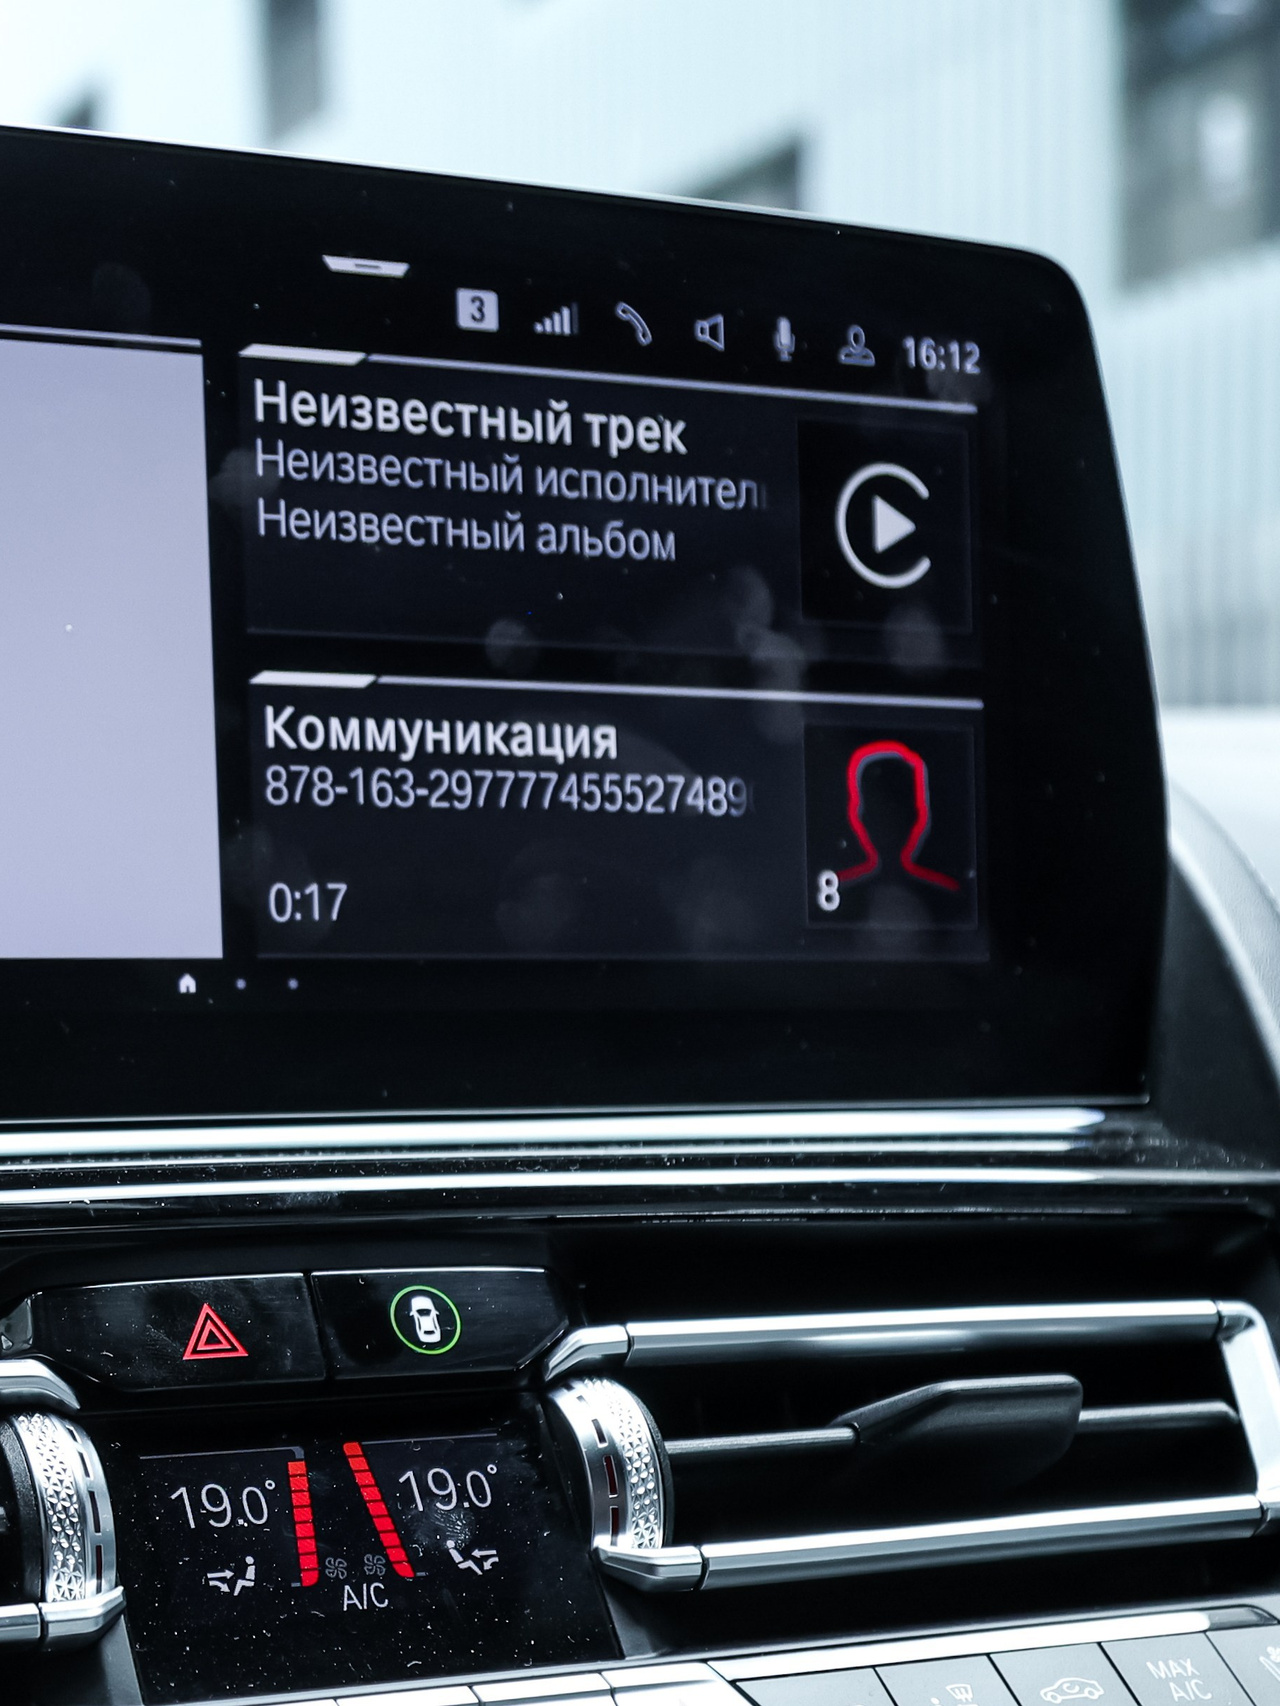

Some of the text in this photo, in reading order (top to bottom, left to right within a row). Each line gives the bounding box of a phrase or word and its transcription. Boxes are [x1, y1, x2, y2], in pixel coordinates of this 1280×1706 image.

[468, 295, 487, 324] 3
[903, 336, 981, 375] 16:12
[254, 378, 687, 457] Неизвестный трек
[256, 439, 523, 495] Неизвестный
[258, 498, 676, 561] Неизвестный альбом
[264, 705, 618, 763] Коммуникация
[265, 765, 754, 816] 878-163-297777455527489
[269, 883, 347, 922] 0:17
[816, 870, 840, 911] 8
[342, 1581, 389, 1611] A/C
[1146, 1658, 1200, 1679] MAX
[1169, 1679, 1212, 1702] A/C
